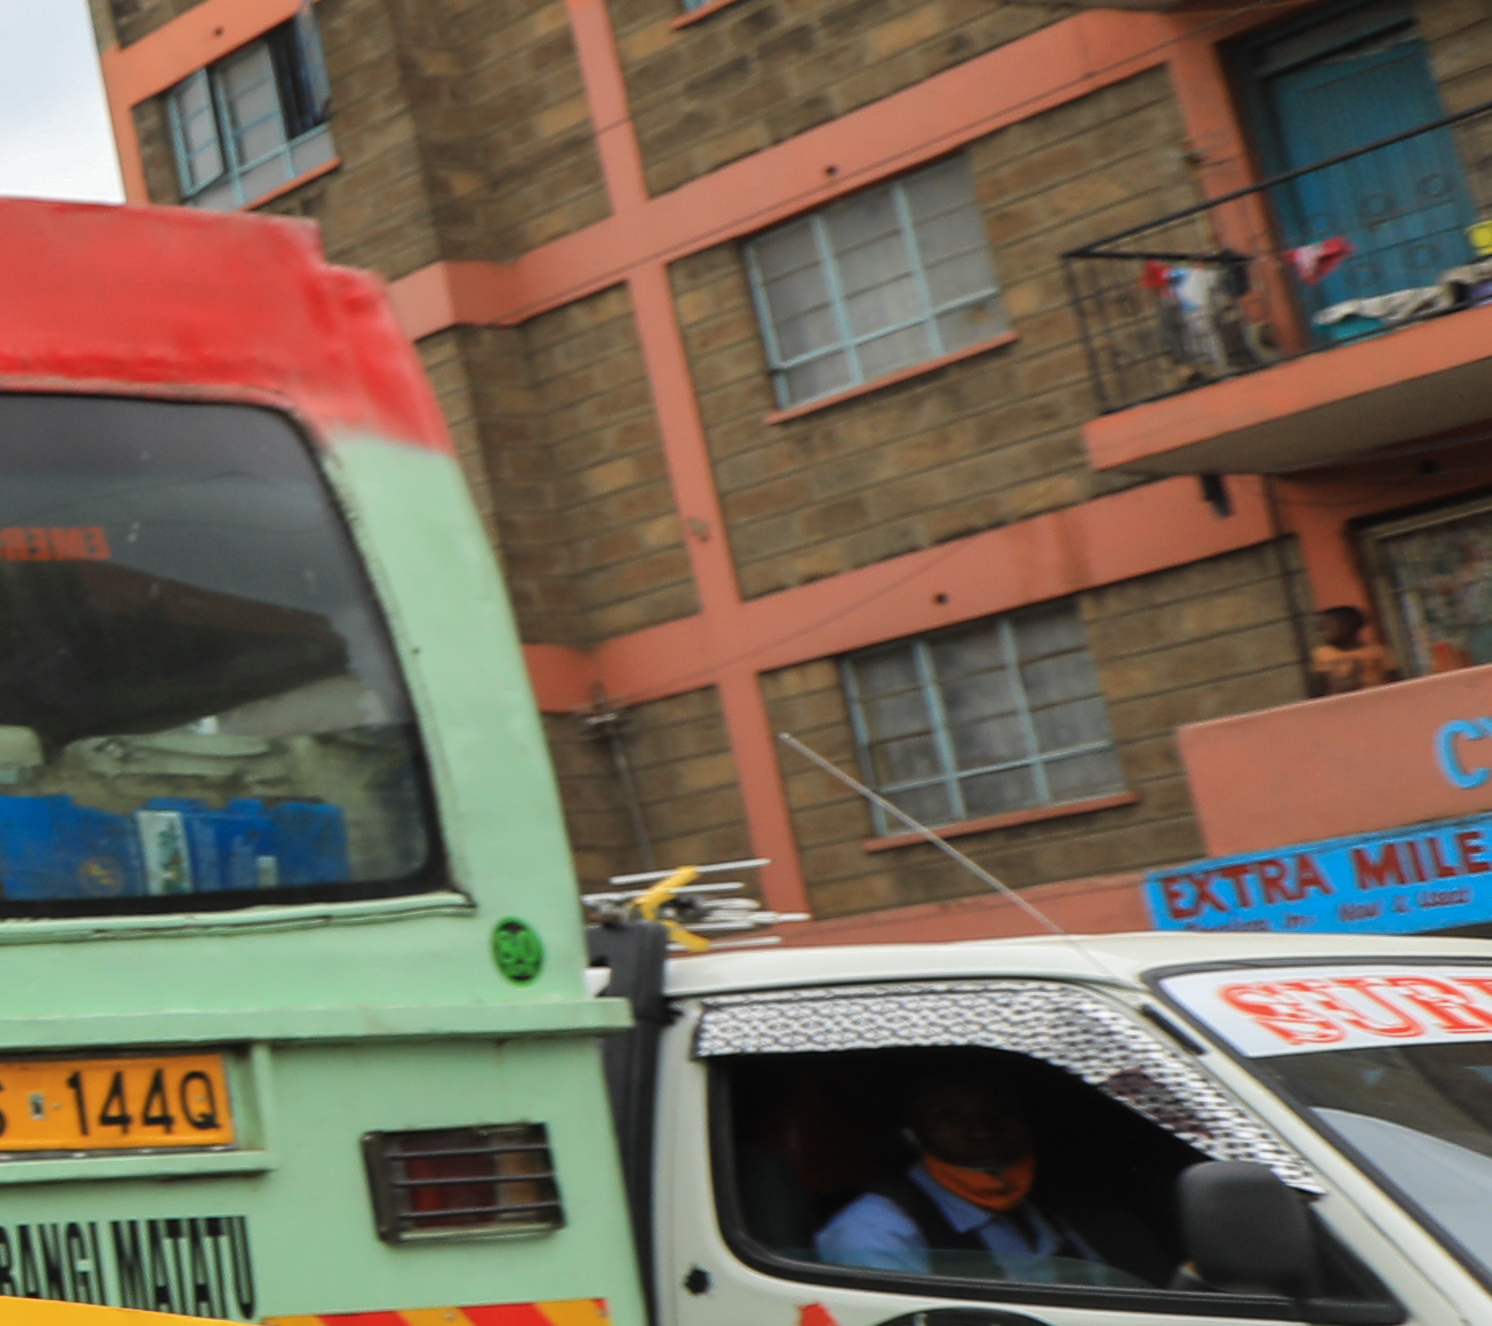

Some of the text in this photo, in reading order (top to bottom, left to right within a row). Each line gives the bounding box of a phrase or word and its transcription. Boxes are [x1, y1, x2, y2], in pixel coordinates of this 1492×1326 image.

[1163, 853, 1335, 920] EXTRA
[1353, 831, 1492, 890] MILE
[65, 1068, 221, 1137] 144Q
[110, 1215, 255, 1321] MATATU
